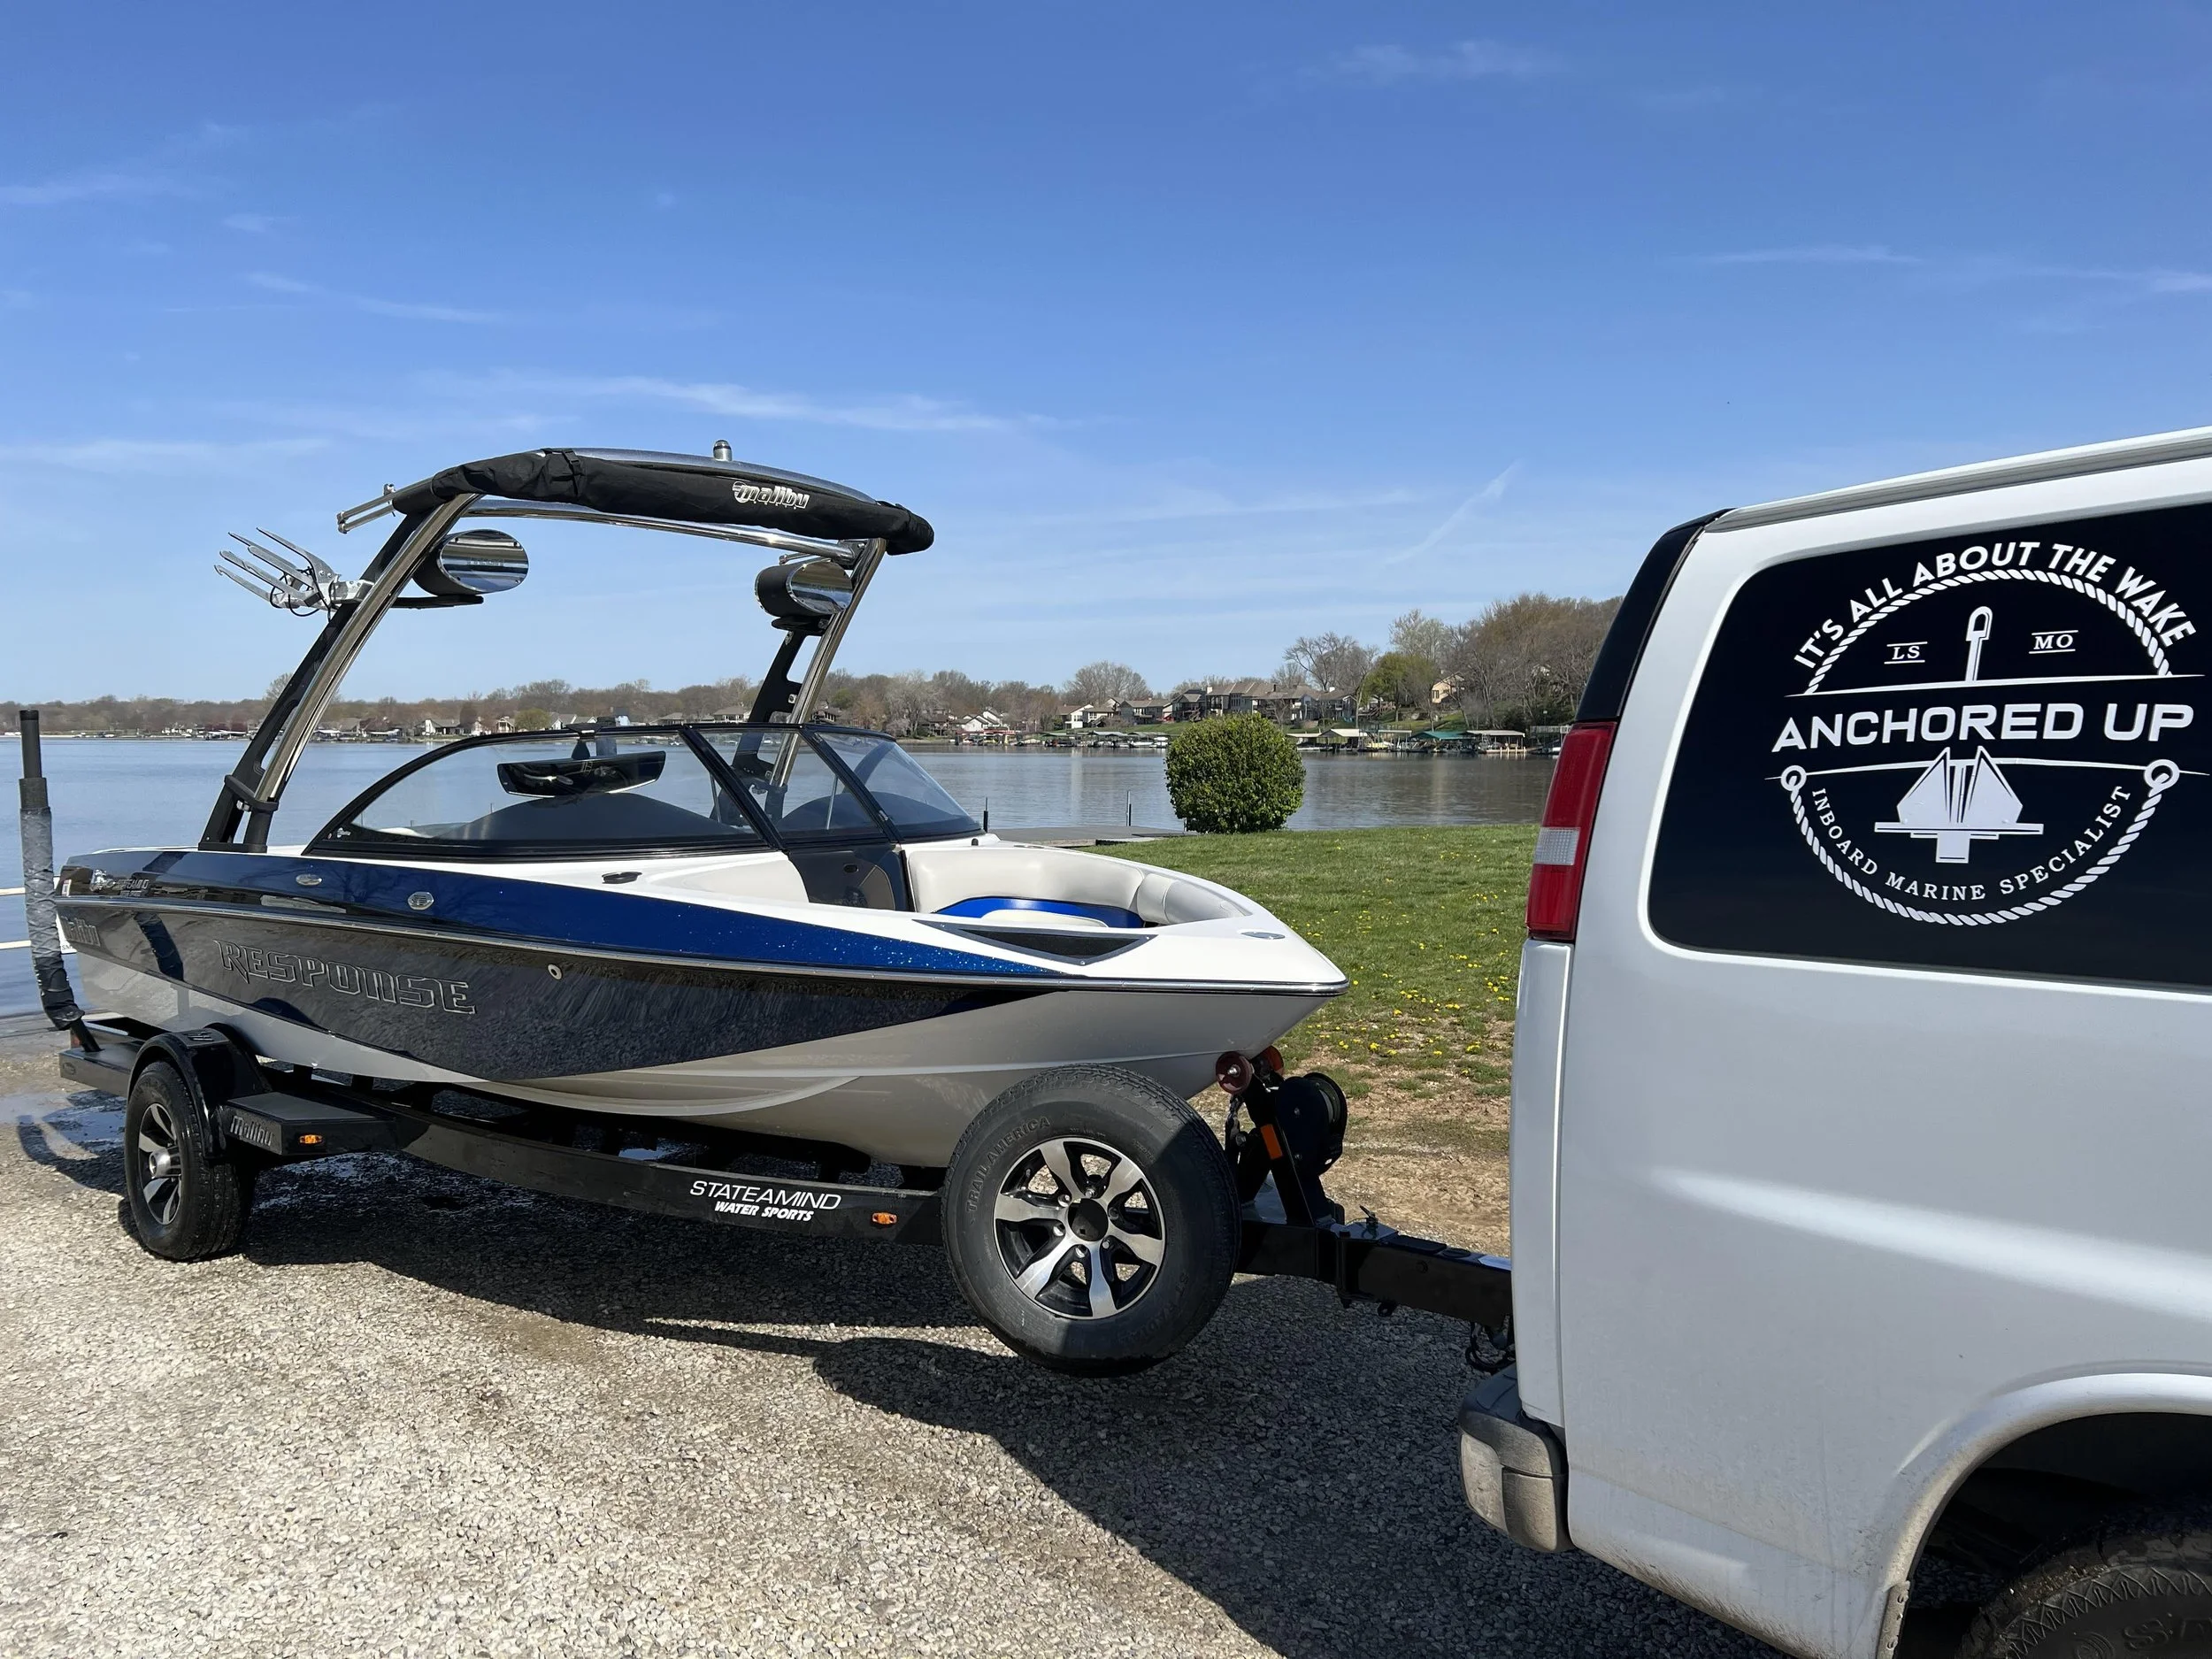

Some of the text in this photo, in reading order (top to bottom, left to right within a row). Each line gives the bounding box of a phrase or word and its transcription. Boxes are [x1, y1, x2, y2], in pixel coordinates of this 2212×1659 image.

[1793, 541, 2197, 670] IT'S ALL ABOUT THE WAKE
[1891, 645, 1920, 660] LS
[2033, 634, 2074, 650] MO
[1771, 703, 2194, 753] ANCHORED UP
[1811, 786, 2131, 901] INBOARD MARINE SPECIALIST
[213, 940, 477, 1014] RESPONSE
[965, 1115, 1052, 1213] TRAIL AMERICA
[689, 1180, 842, 1210] STATEAMIND
[714, 1201, 815, 1222] WATER SPORTS
